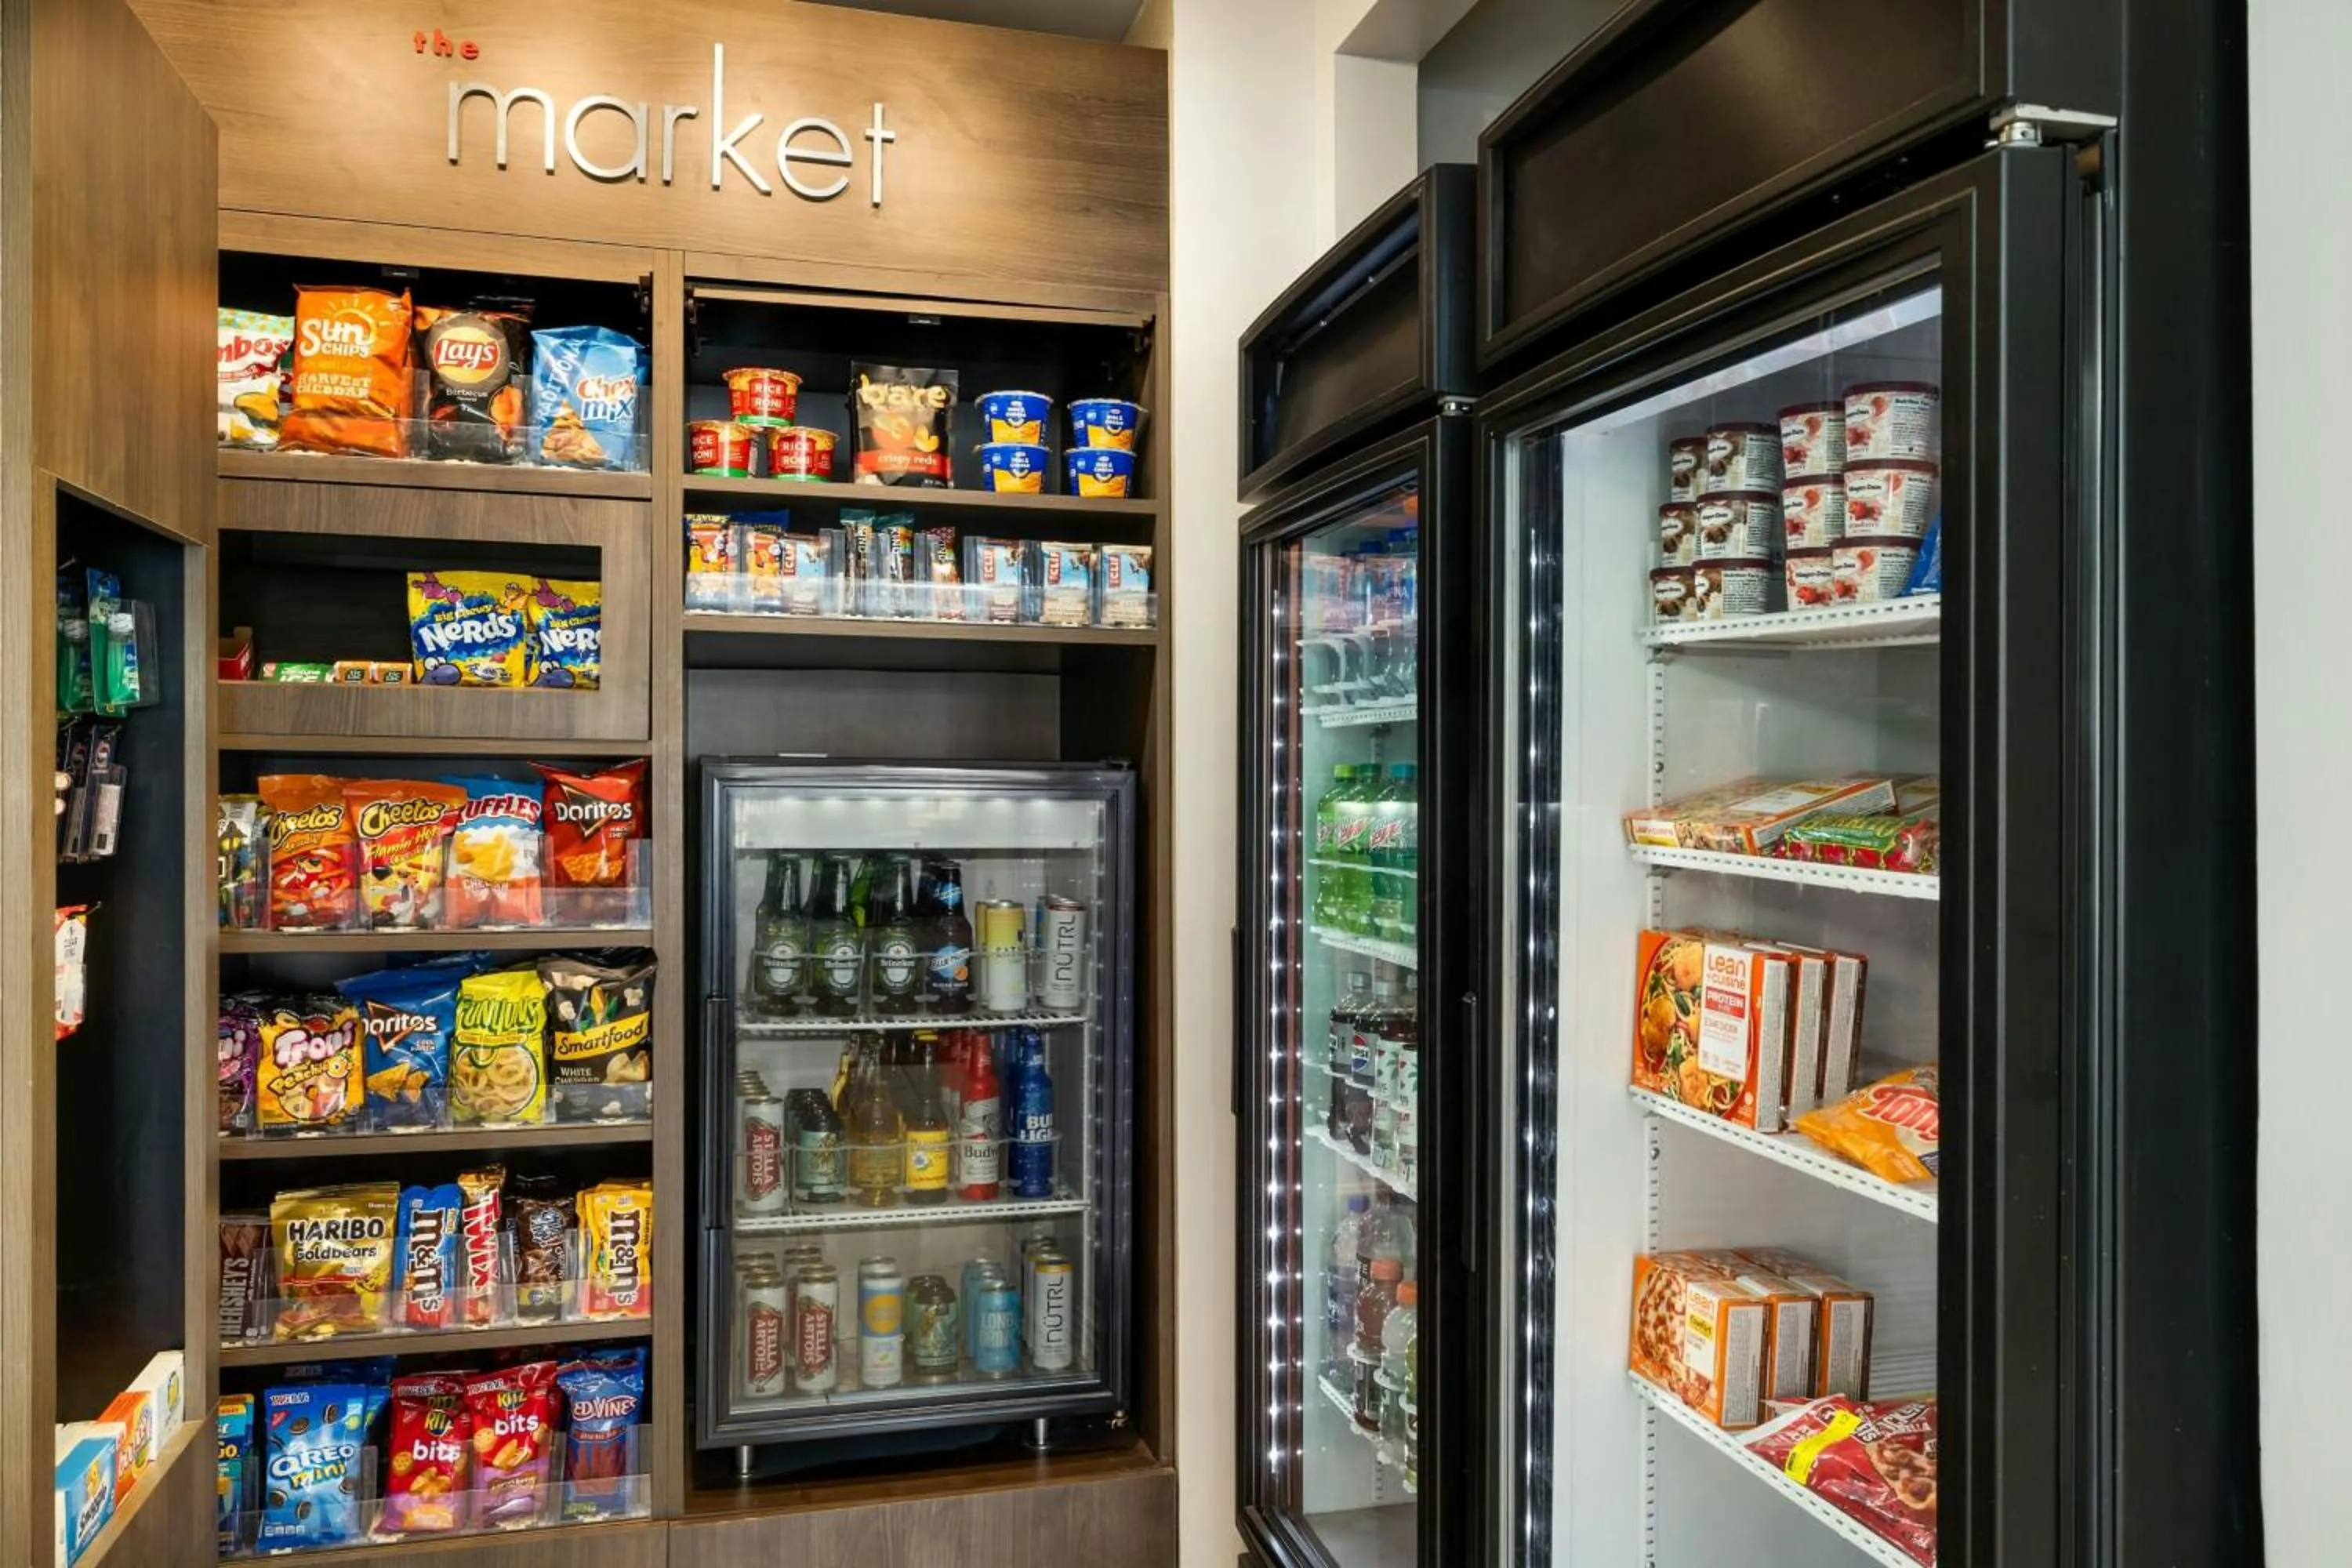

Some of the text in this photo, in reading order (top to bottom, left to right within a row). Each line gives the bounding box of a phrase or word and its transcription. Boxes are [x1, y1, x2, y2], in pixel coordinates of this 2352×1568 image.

[414, 29, 480, 60] the
[448, 42, 896, 208] market
[321, 343, 371, 358] CHIPS
[296, 385, 370, 399] CHEDDAR
[298, 374, 372, 389] HARVEST
[577, 375, 637, 400] Chex
[754, 383, 782, 394] RICE
[860, 374, 947, 408] bare
[755, 397, 782, 408] RONI
[782, 441, 810, 452] RICE
[782, 455, 810, 466] RONI
[878, 453, 937, 465] crispy reds
[569, 614, 601, 626] Chew
[361, 799, 445, 837] Cheetos
[465, 795, 541, 823] UFFLES
[554, 802, 633, 821] Doritos
[271, 807, 340, 845] Cheetos
[1708, 953, 1747, 979] Lean
[557, 1021, 645, 1055] Smartfood
[560, 1066, 593, 1076] WHITE
[288, 1218, 385, 1242] HARIBO
[296, 1245, 377, 1262] Goldbears
[462, 1188, 500, 1297] TWIX
[765, 1319, 778, 1370] STELLA
[804, 1312, 815, 1365] ARTOIS
[815, 1312, 828, 1364] STELLA
[495, 1414, 540, 1436] bits
[271, 1444, 355, 1477] OREO
[412, 1439, 462, 1461] bits
[292, 1461, 347, 1491] mini
